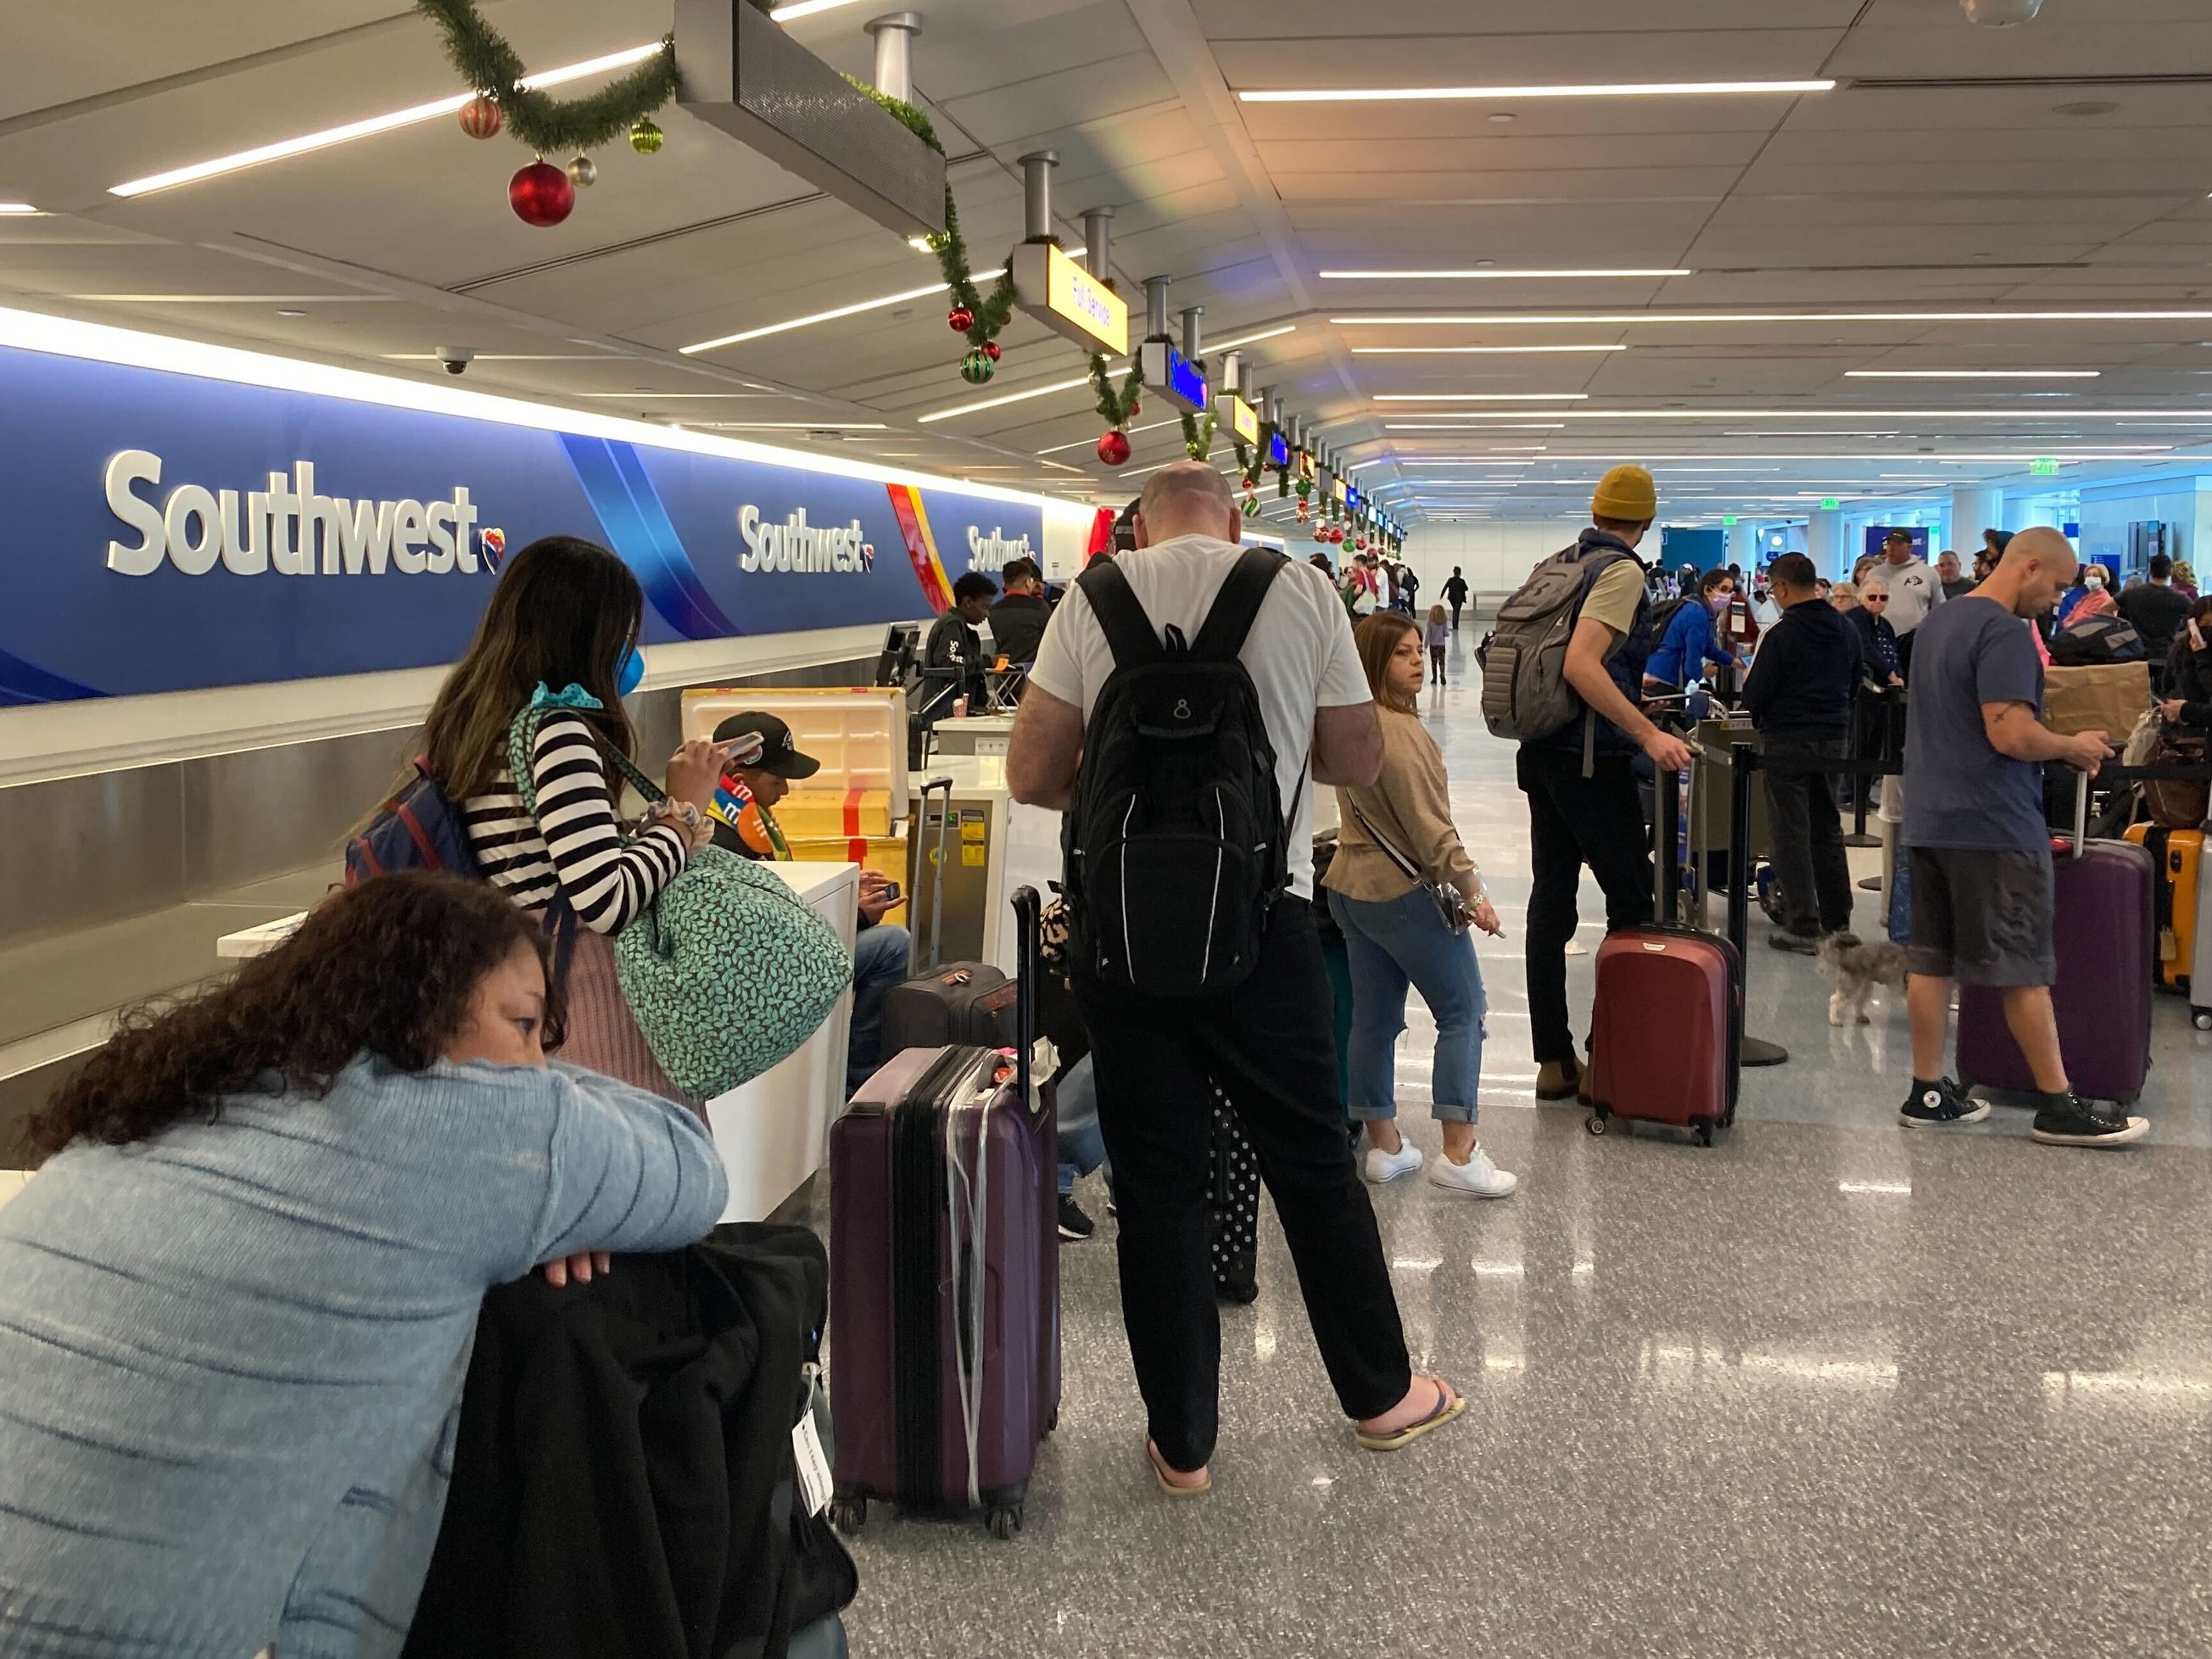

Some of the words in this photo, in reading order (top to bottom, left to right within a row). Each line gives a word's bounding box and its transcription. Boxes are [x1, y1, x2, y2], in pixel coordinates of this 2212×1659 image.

[105, 450, 478, 576] Southwest
[741, 505, 863, 573] Southwest
[723, 802, 742, 824] m
[732, 785, 753, 802] m
